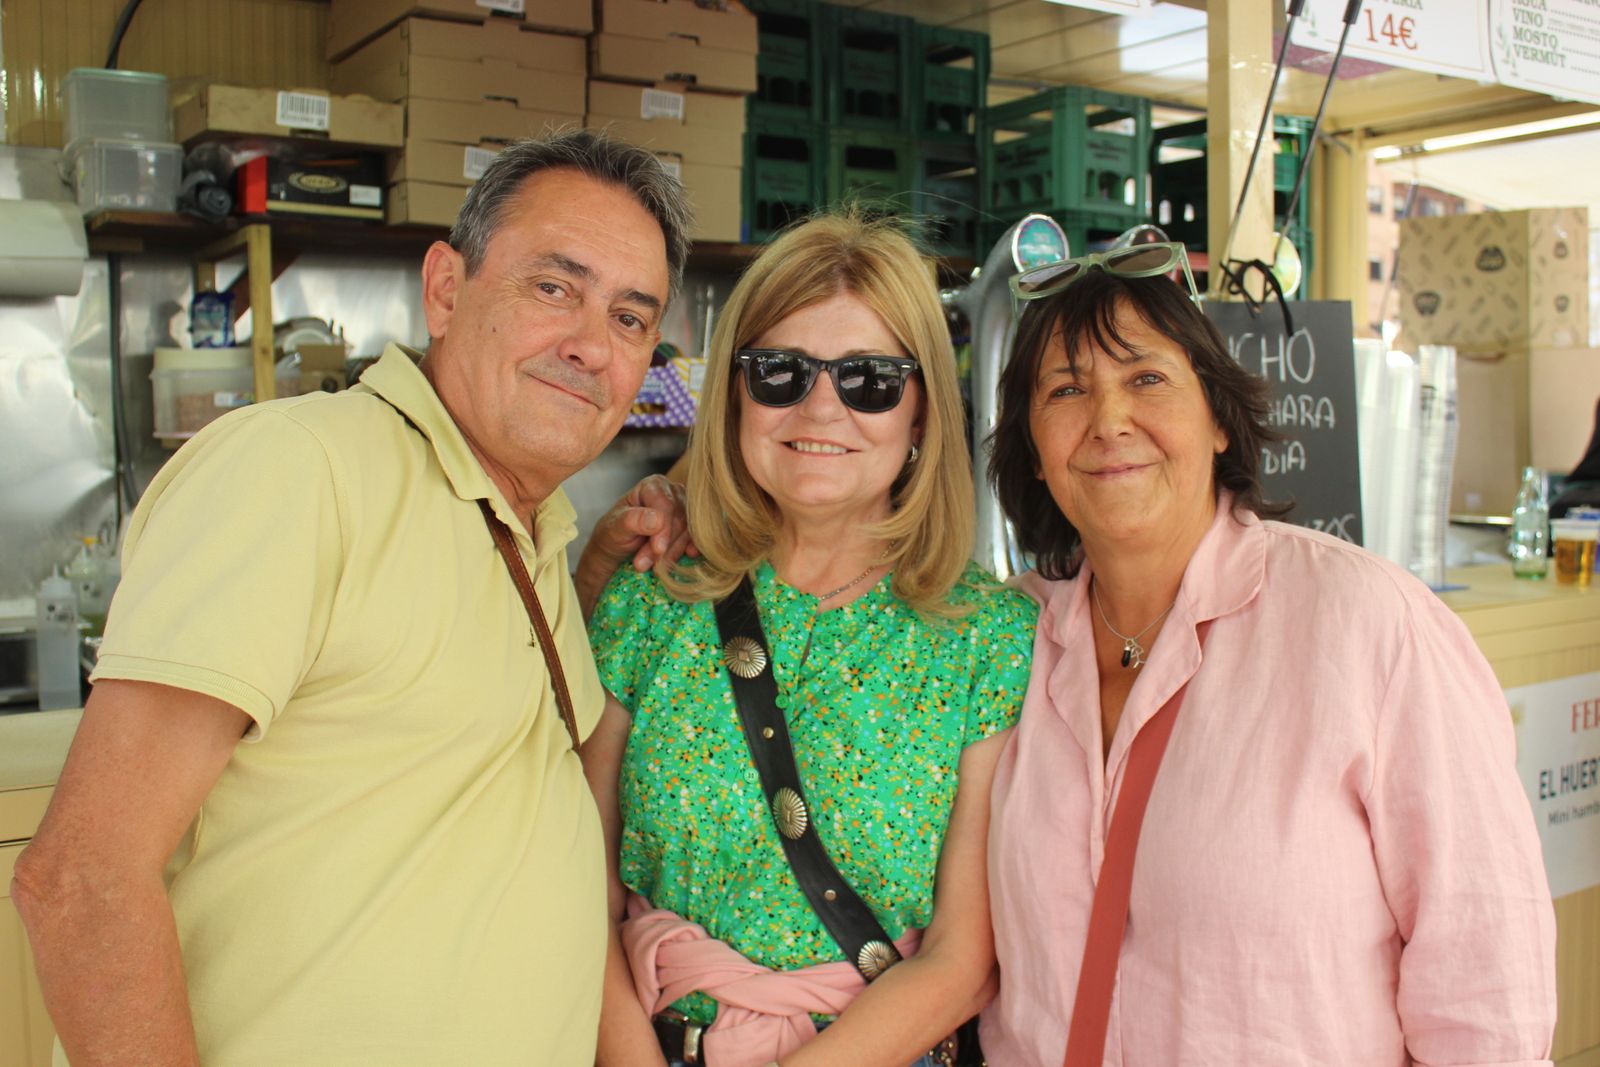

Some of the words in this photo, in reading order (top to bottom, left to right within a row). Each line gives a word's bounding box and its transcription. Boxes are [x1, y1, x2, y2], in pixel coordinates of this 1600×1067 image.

[1364, 8, 1418, 50] 14€
[1512, 7, 1543, 28] VINO
[1513, 25, 1558, 49] MOSTO
[1513, 43, 1567, 68] VERMUT
[1228, 327, 1315, 384] CHO
[1257, 393, 1336, 430] HARA
[1539, 768, 1557, 801] EL
[1560, 756, 1600, 794] HUER
